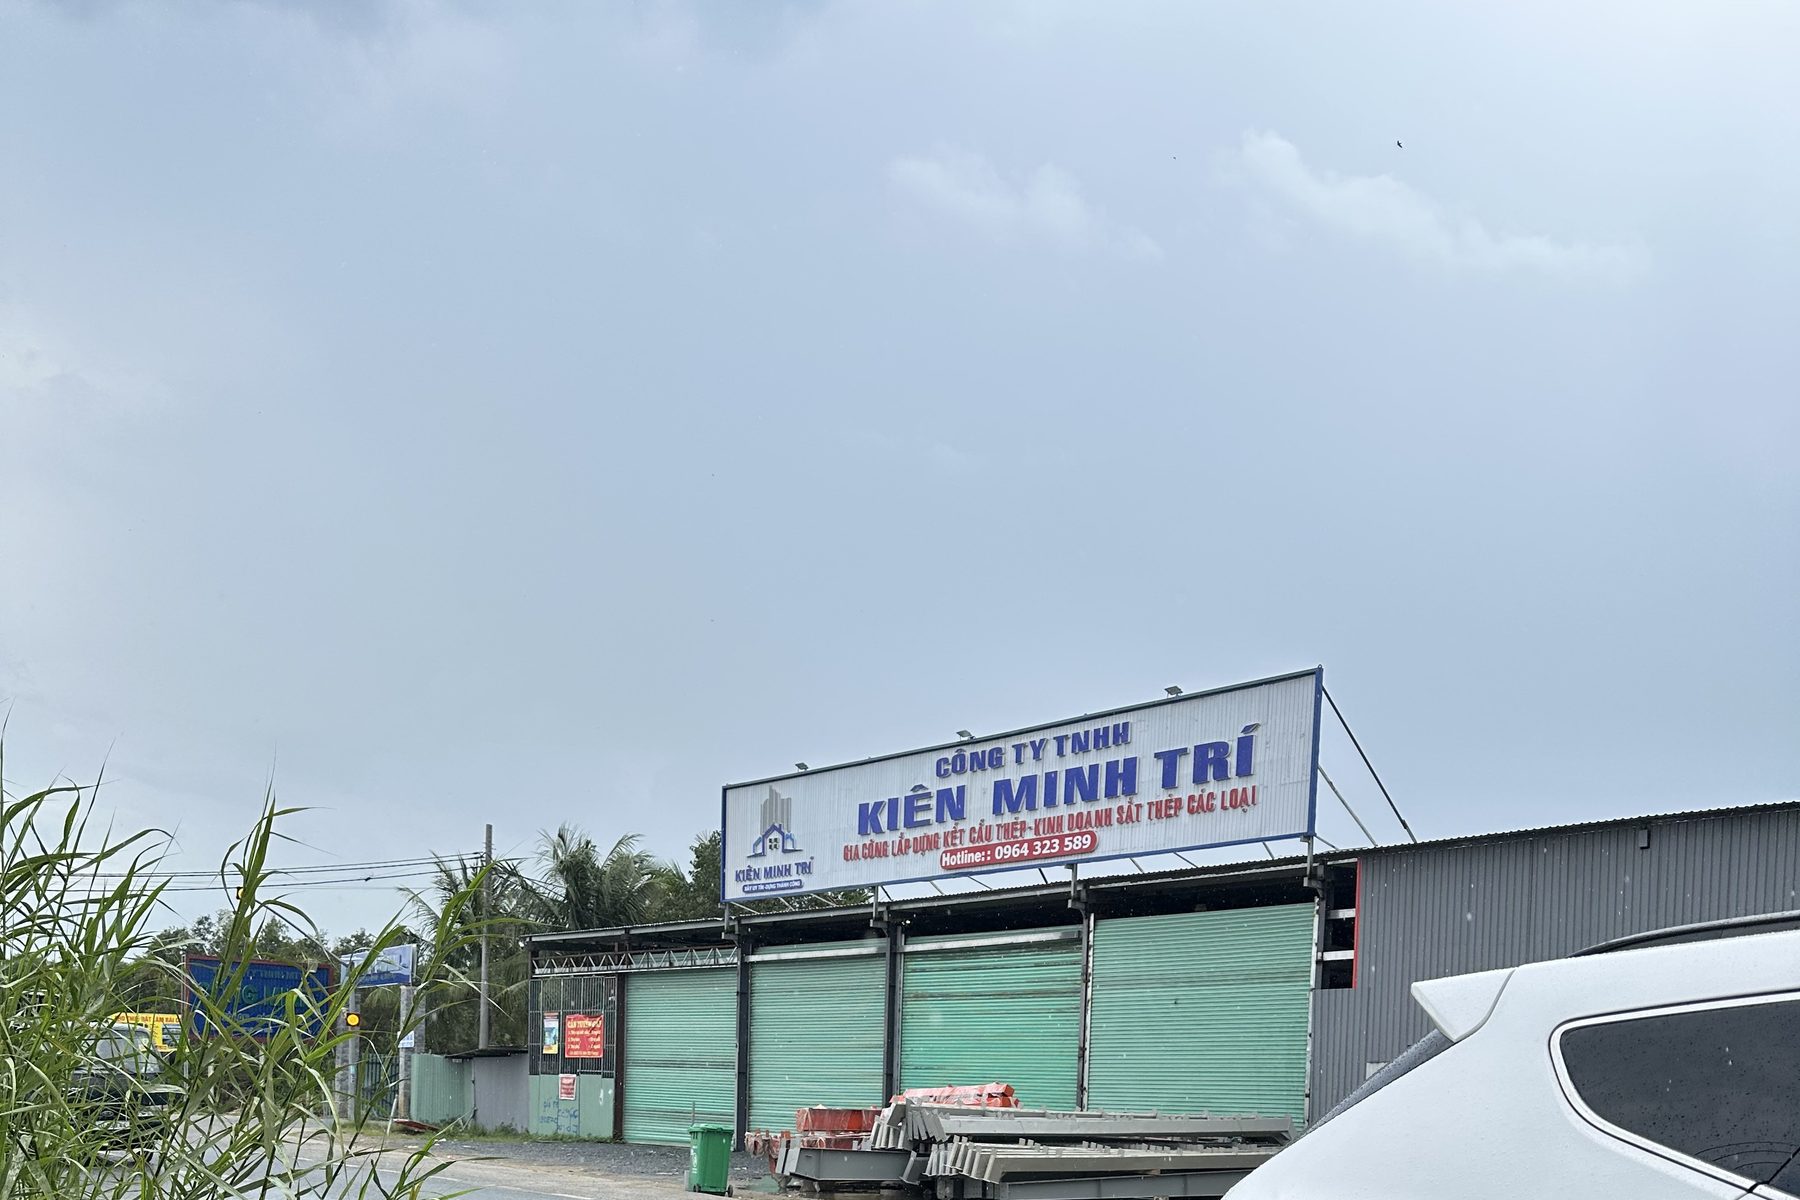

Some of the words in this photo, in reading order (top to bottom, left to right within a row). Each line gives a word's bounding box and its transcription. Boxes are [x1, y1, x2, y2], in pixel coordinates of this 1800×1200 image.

[858, 784, 967, 835] KIÊN
[992, 756, 1139, 816] MINH
[1154, 722, 1261, 790] TRÍ
[935, 749, 1005, 779] CÔNG
[1012, 738, 1048, 765] TY
[1053, 721, 1131, 759] TNHH
[844, 844, 860, 861] GIA
[862, 839, 889, 860] CÔNG
[913, 834, 940, 857] DỰNG
[943, 822, 965, 847] KẾT
[1067, 808, 1113, 832] DOANH
[1116, 797, 1143, 825] SẮT
[1147, 793, 1183, 820] THÉP
[1187, 788, 1216, 814] CÁC
[1220, 785, 1257, 813] LOẠI
[994, 842, 1030, 860] 0964
[1033, 839, 1060, 855] 323
[1063, 835, 1092, 851] 589
[735, 865, 761, 882] KIÊN
[764, 864, 792, 880] MINH
[795, 856, 814, 876] TRÍ
